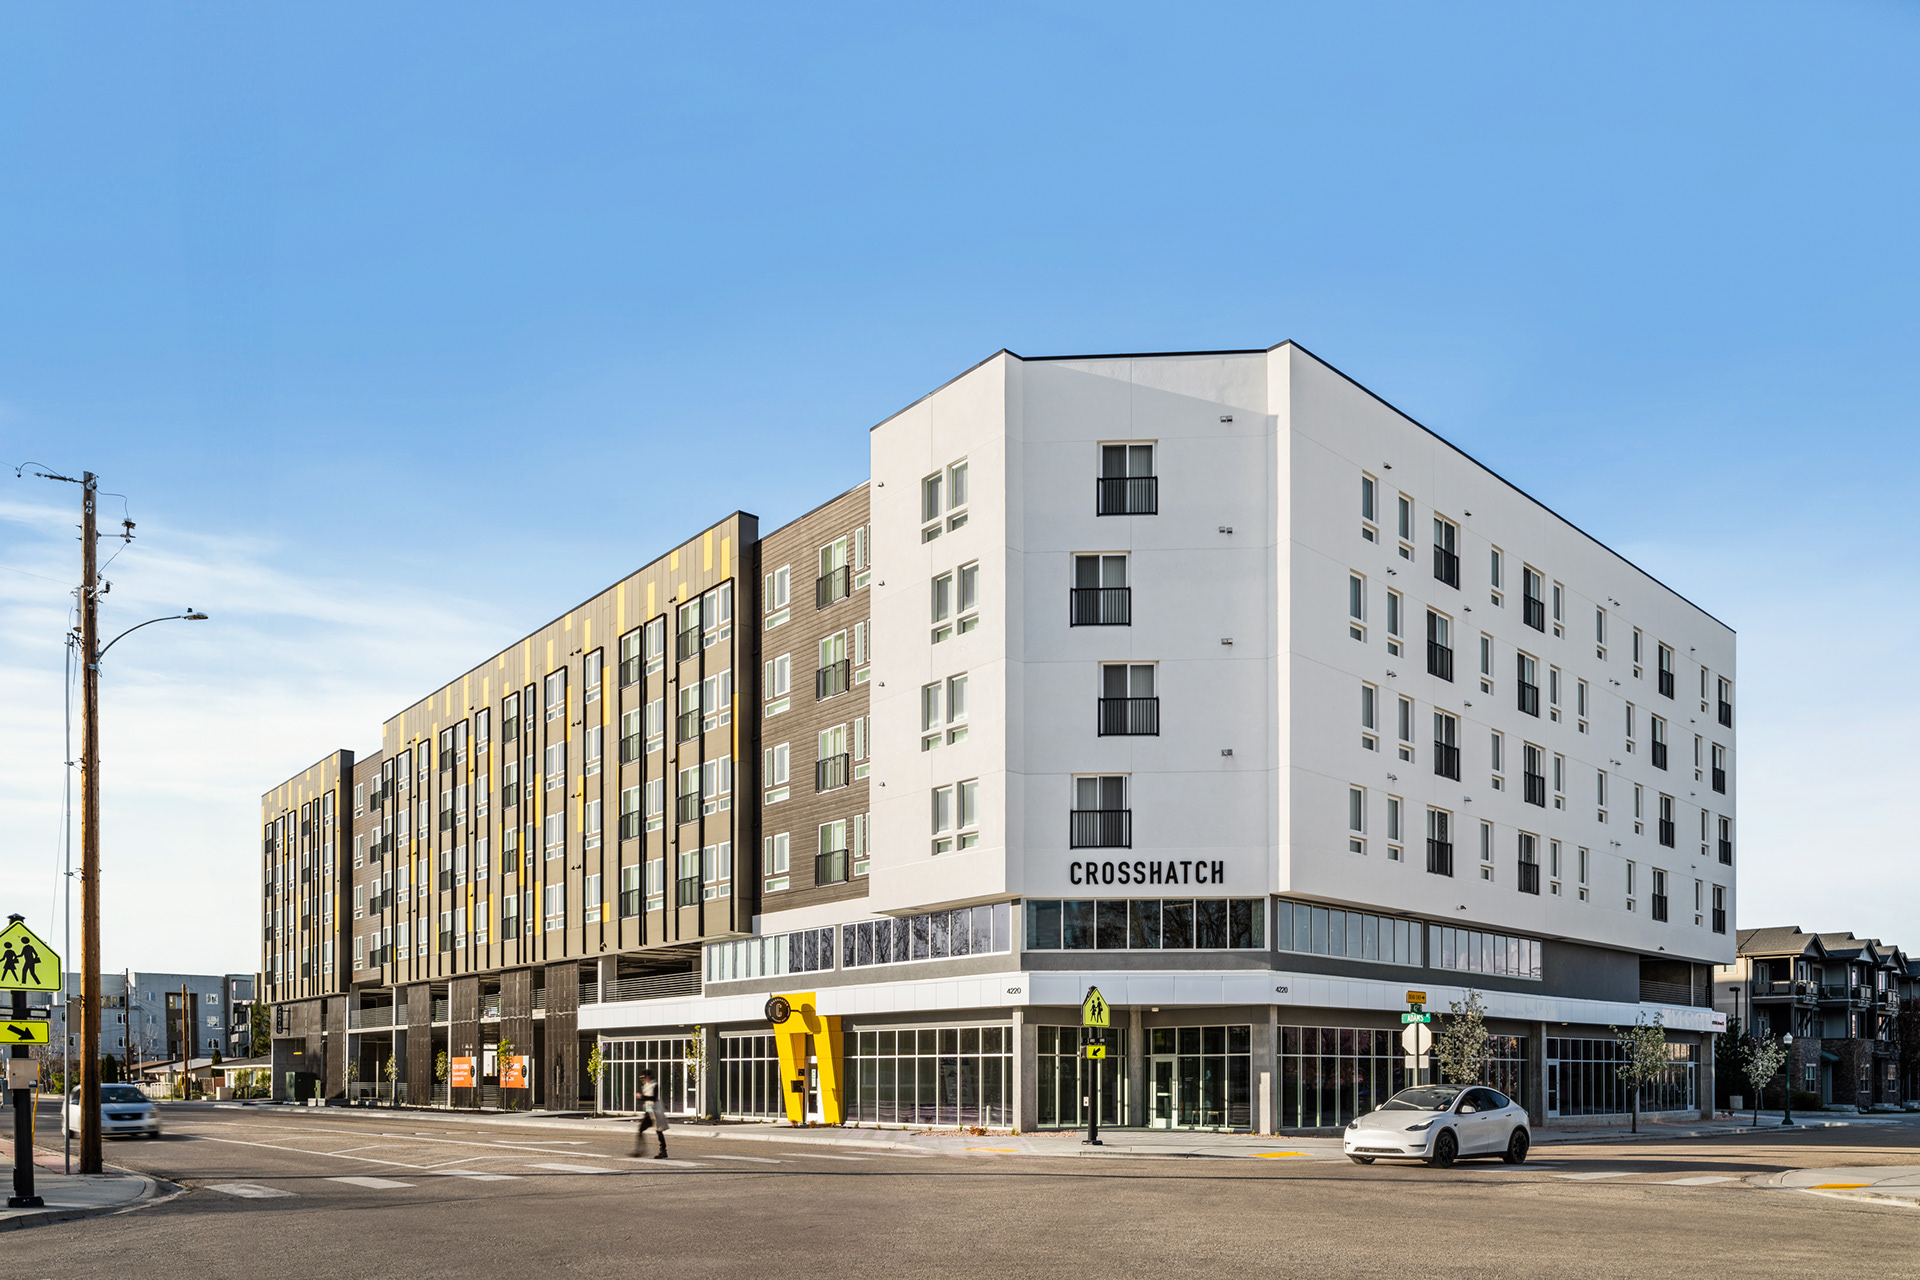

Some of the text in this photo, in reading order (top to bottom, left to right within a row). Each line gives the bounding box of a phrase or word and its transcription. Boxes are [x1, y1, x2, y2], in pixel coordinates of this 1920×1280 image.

[1070, 861, 1224, 885] CROSSHATCH
[1006, 987, 1022, 995] 4220
[1275, 986, 1289, 994] 4220
[1407, 1013, 1424, 1023] ADAMS
